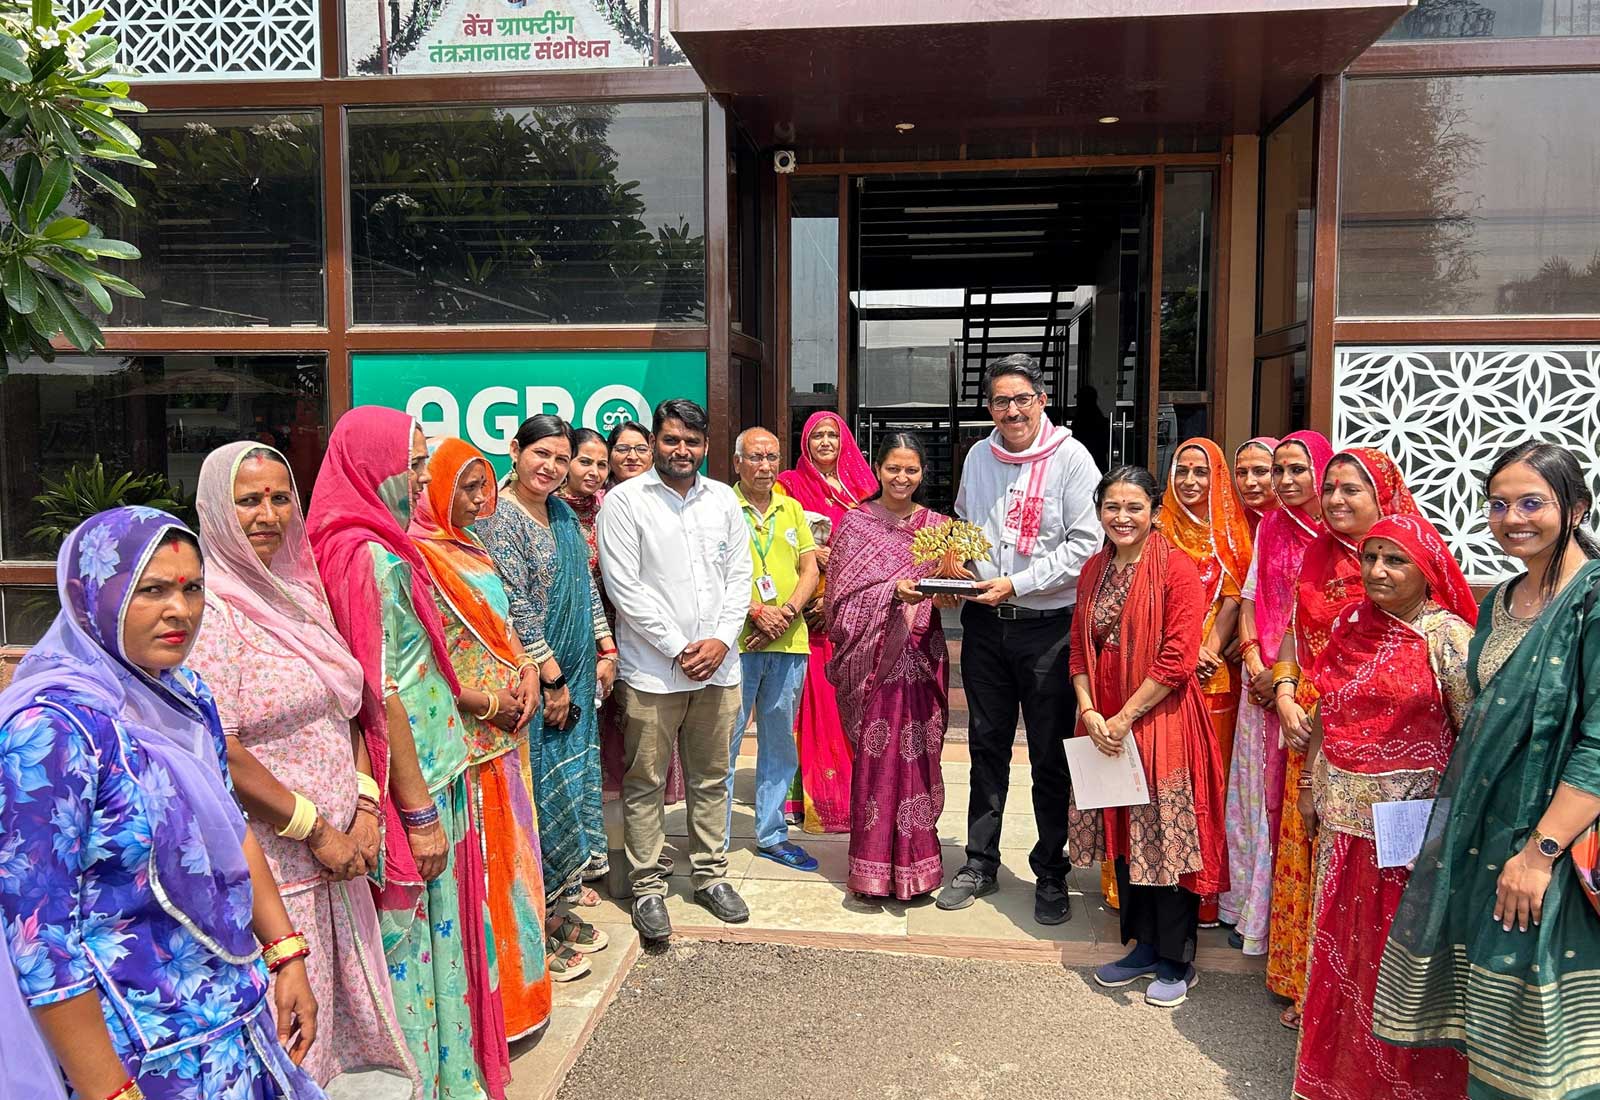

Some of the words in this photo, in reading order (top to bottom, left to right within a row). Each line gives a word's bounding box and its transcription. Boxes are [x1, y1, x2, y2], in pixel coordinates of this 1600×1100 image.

[463, 14, 493, 36] बेंच
[428, 40, 531, 63] तंत्रज्ञानावर
[534, 36, 611, 60] संशोधन
